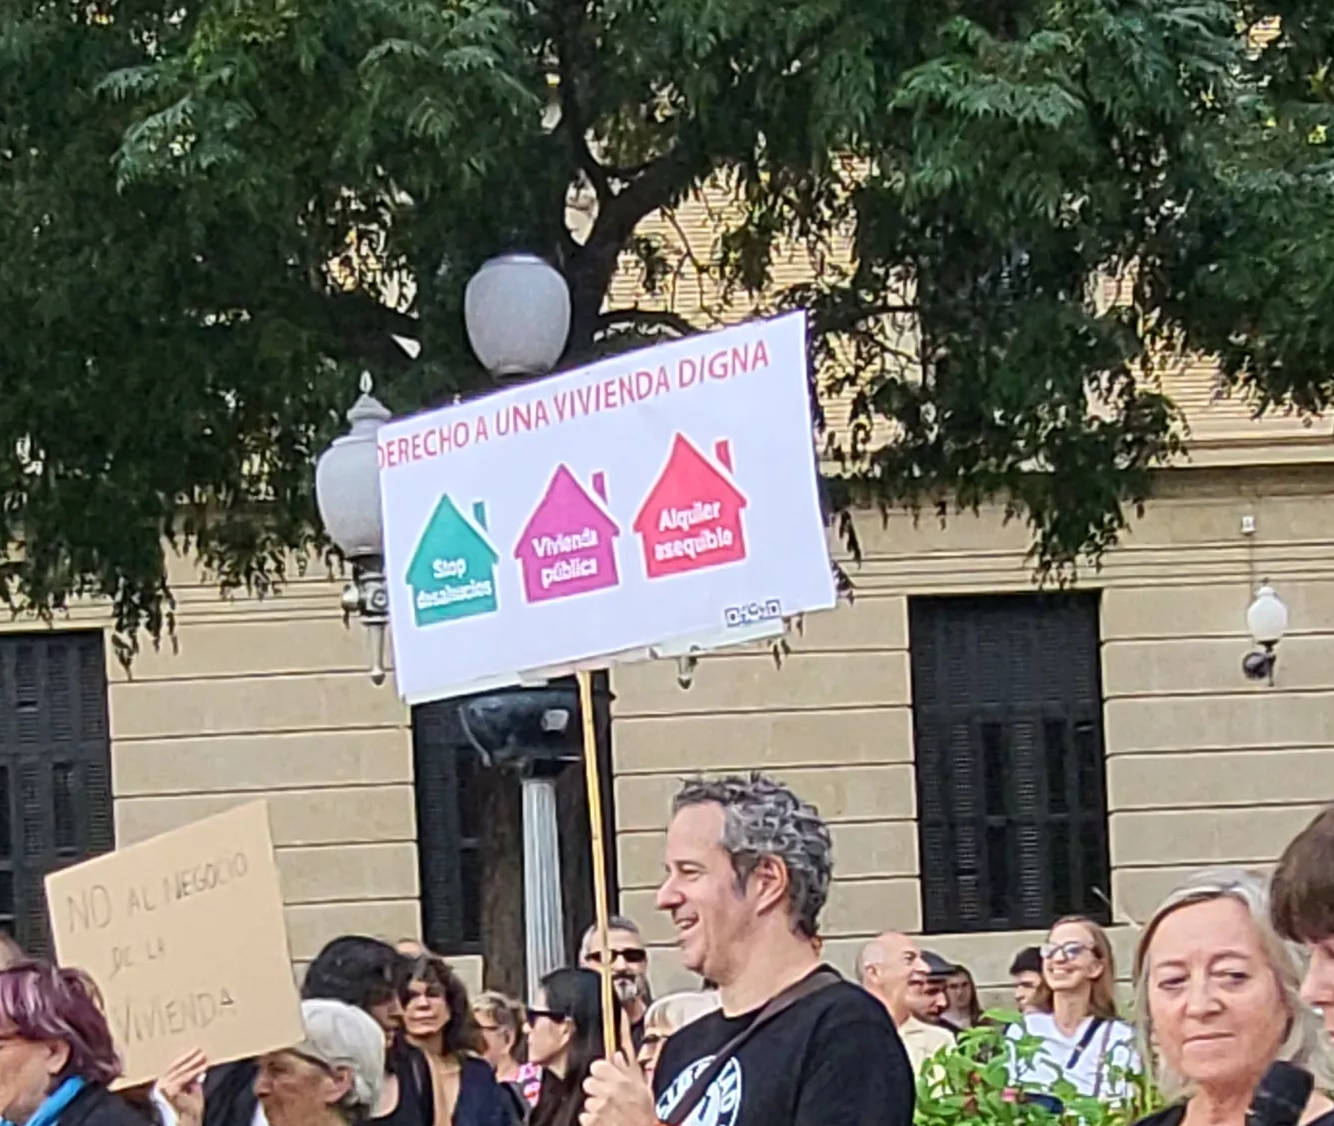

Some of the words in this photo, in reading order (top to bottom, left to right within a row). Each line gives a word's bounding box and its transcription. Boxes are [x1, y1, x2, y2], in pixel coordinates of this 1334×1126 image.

[474, 416, 489, 444] A
[495, 399, 550, 437] UNA
[553, 365, 671, 424] VIVIENDA
[678, 339, 770, 389] DIGNA
[659, 501, 721, 532] Alquiler
[531, 527, 599, 558] Vivienda
[654, 526, 734, 561] asequible
[432, 557, 467, 580] Stop
[540, 557, 599, 589] pública
[417, 578, 493, 609] desahucios
[66, 884, 113, 934] NO
[127, 885, 156, 918] AL
[164, 852, 249, 901] NEGOCIO
[109, 944, 134, 981] DE
[146, 936, 166, 960] LA
[115, 986, 238, 1047] VIVIENDA
